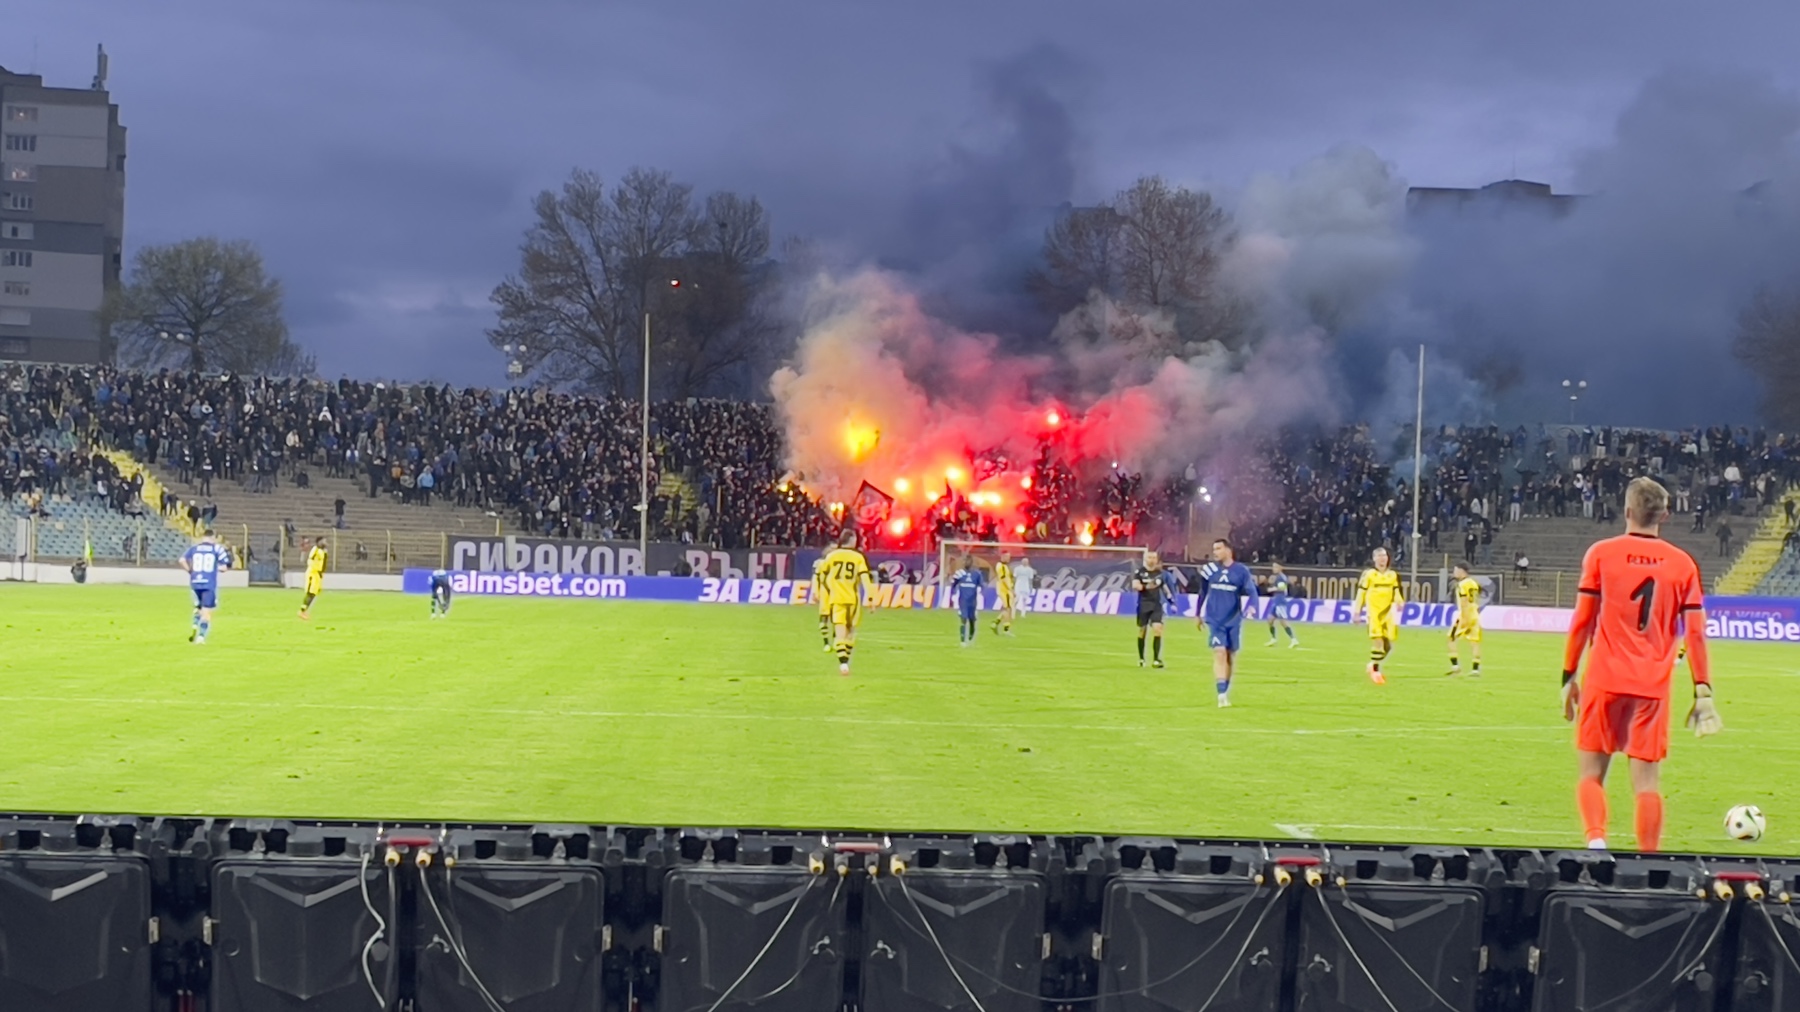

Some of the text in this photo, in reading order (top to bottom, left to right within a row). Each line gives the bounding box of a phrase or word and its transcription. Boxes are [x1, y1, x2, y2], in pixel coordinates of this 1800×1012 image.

[833, 561, 855, 579] 79
[449, 571, 626, 597] almsbet.com
[698, 578, 740, 602] ЗА
[992, 587, 1121, 614] ЕВСКИ
[1630, 576, 1655, 631] 1
[1705, 615, 1800, 640] almsbe
